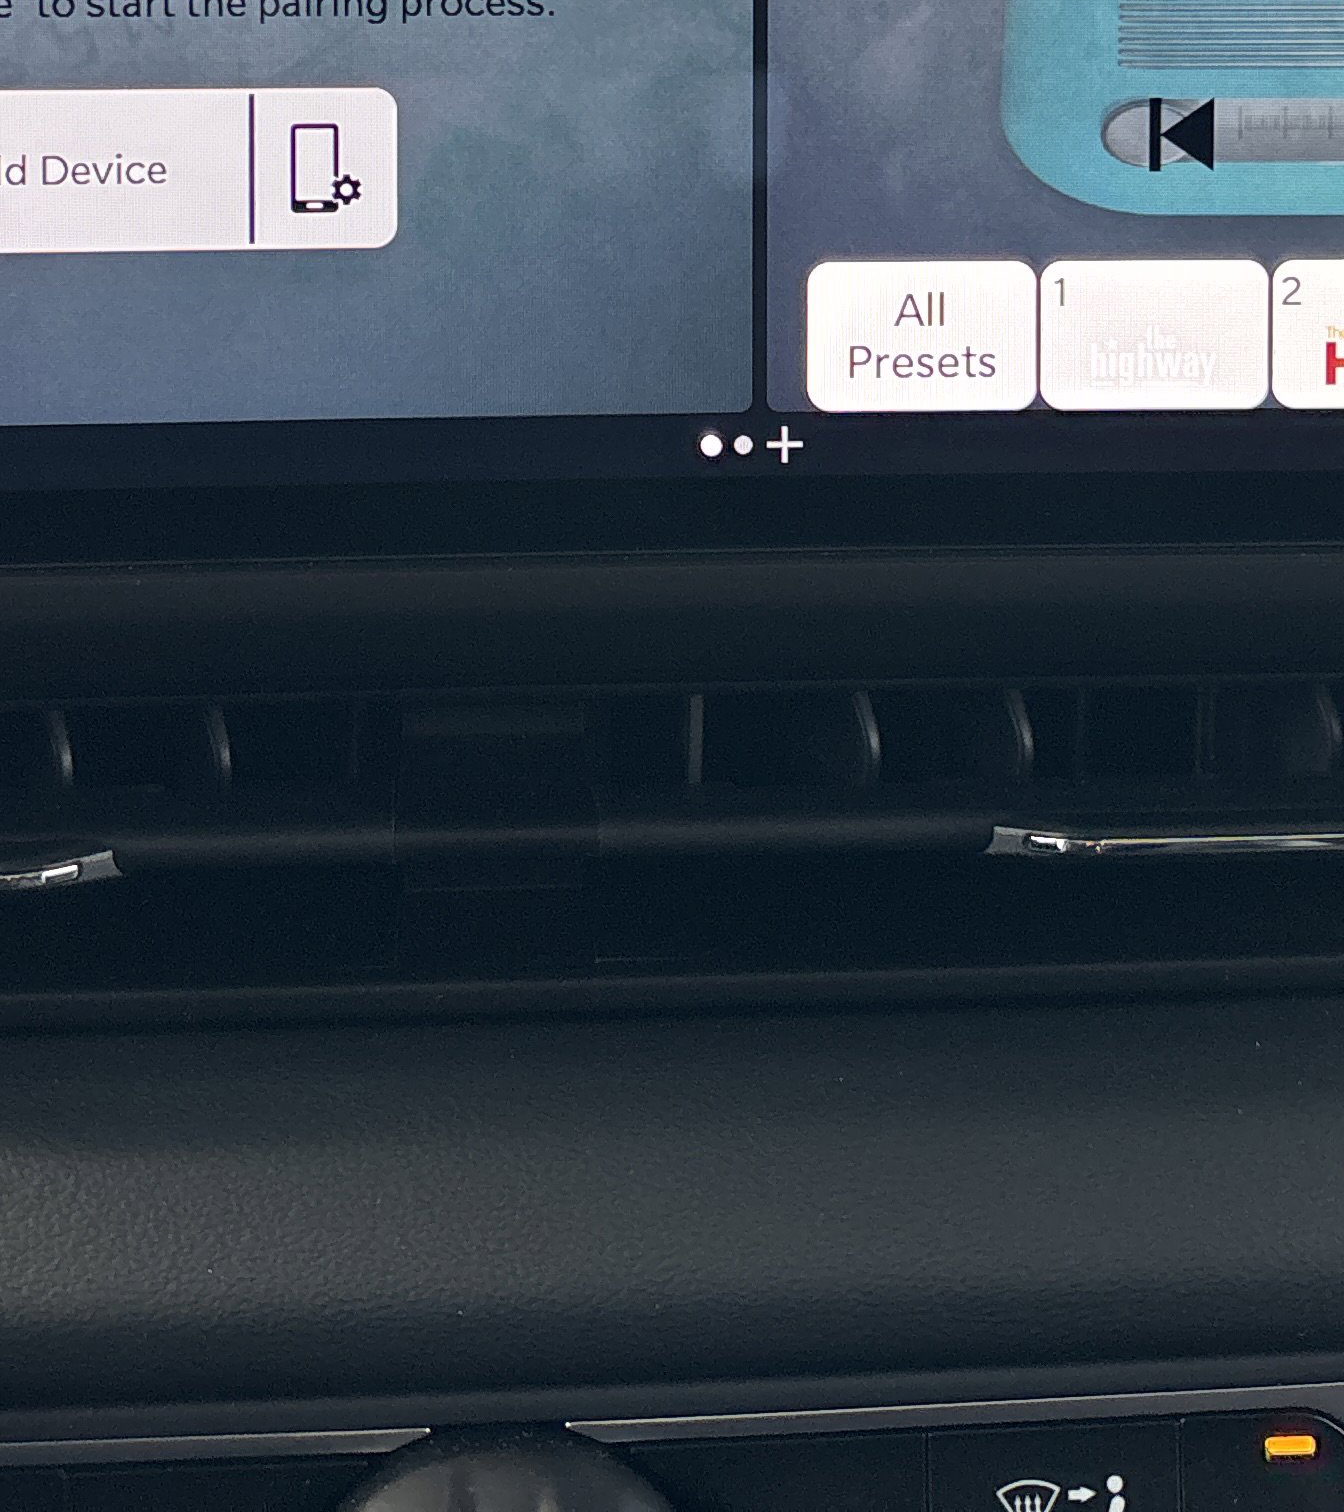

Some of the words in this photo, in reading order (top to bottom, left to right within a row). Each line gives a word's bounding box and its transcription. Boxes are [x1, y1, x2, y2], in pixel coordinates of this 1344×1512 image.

[41, 153, 168, 186] Device
[1053, 277, 1067, 307] 1
[1282, 277, 1302, 306] 2
[893, 291, 946, 327] All
[848, 345, 997, 379] Presets
[1090, 338, 1217, 390] highway
